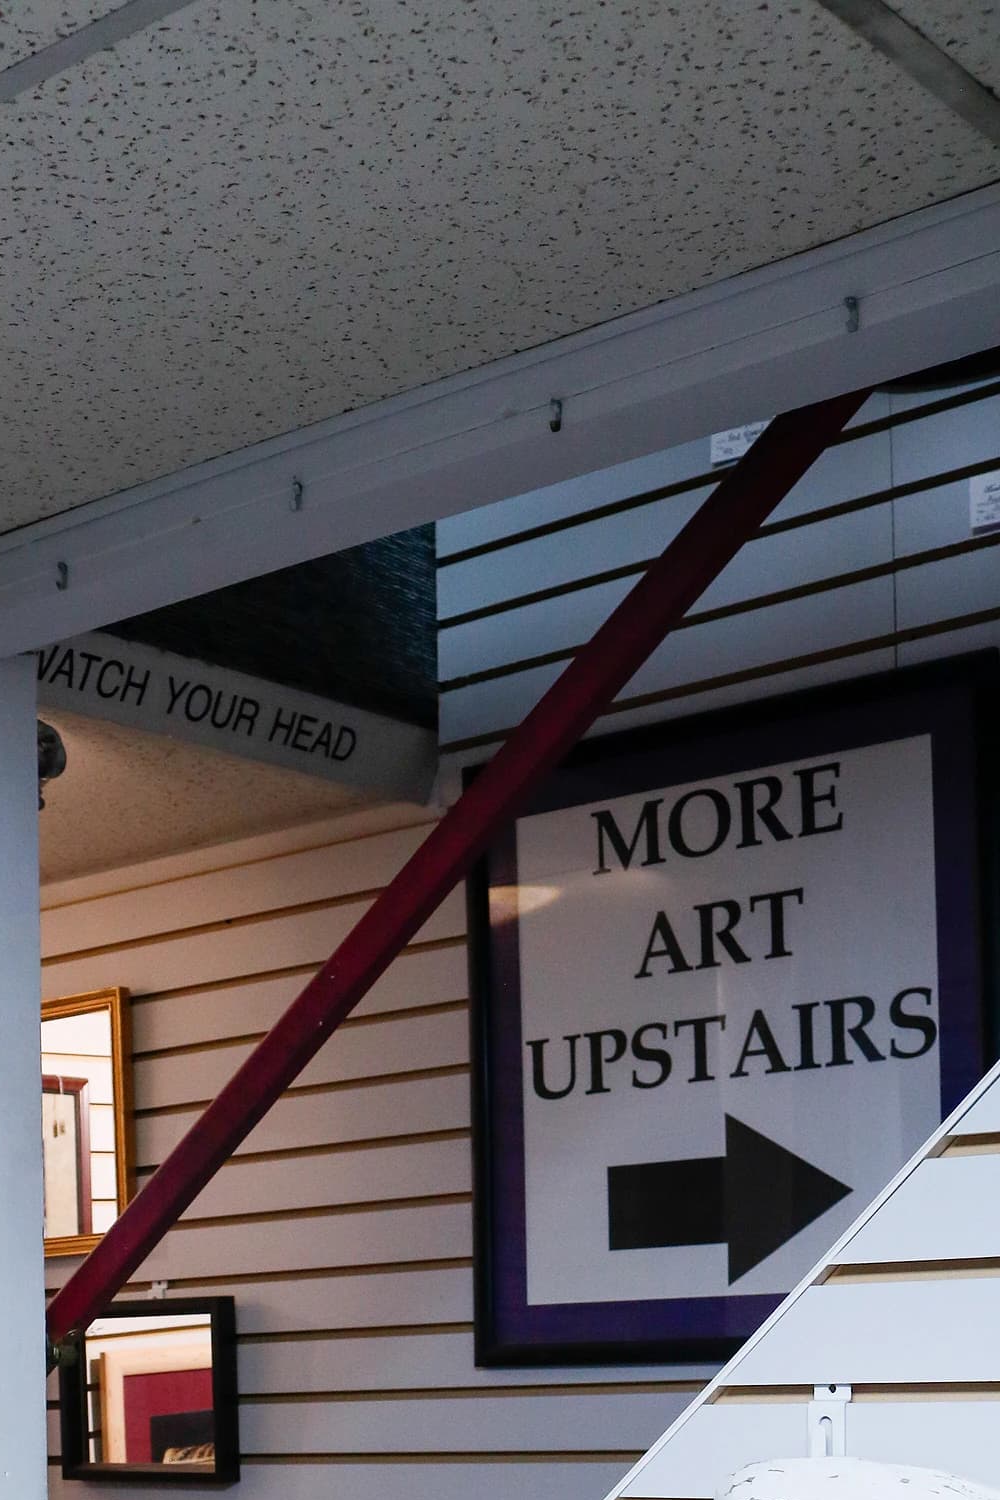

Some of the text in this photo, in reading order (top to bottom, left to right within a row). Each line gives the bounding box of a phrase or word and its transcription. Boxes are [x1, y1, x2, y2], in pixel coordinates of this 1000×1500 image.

[166, 676, 260, 736] YOUR
[268, 709, 356, 761] HEAD
[591, 762, 845, 876] MORE
[634, 888, 804, 979] ART
[527, 987, 937, 1100] UPSTAIRS
